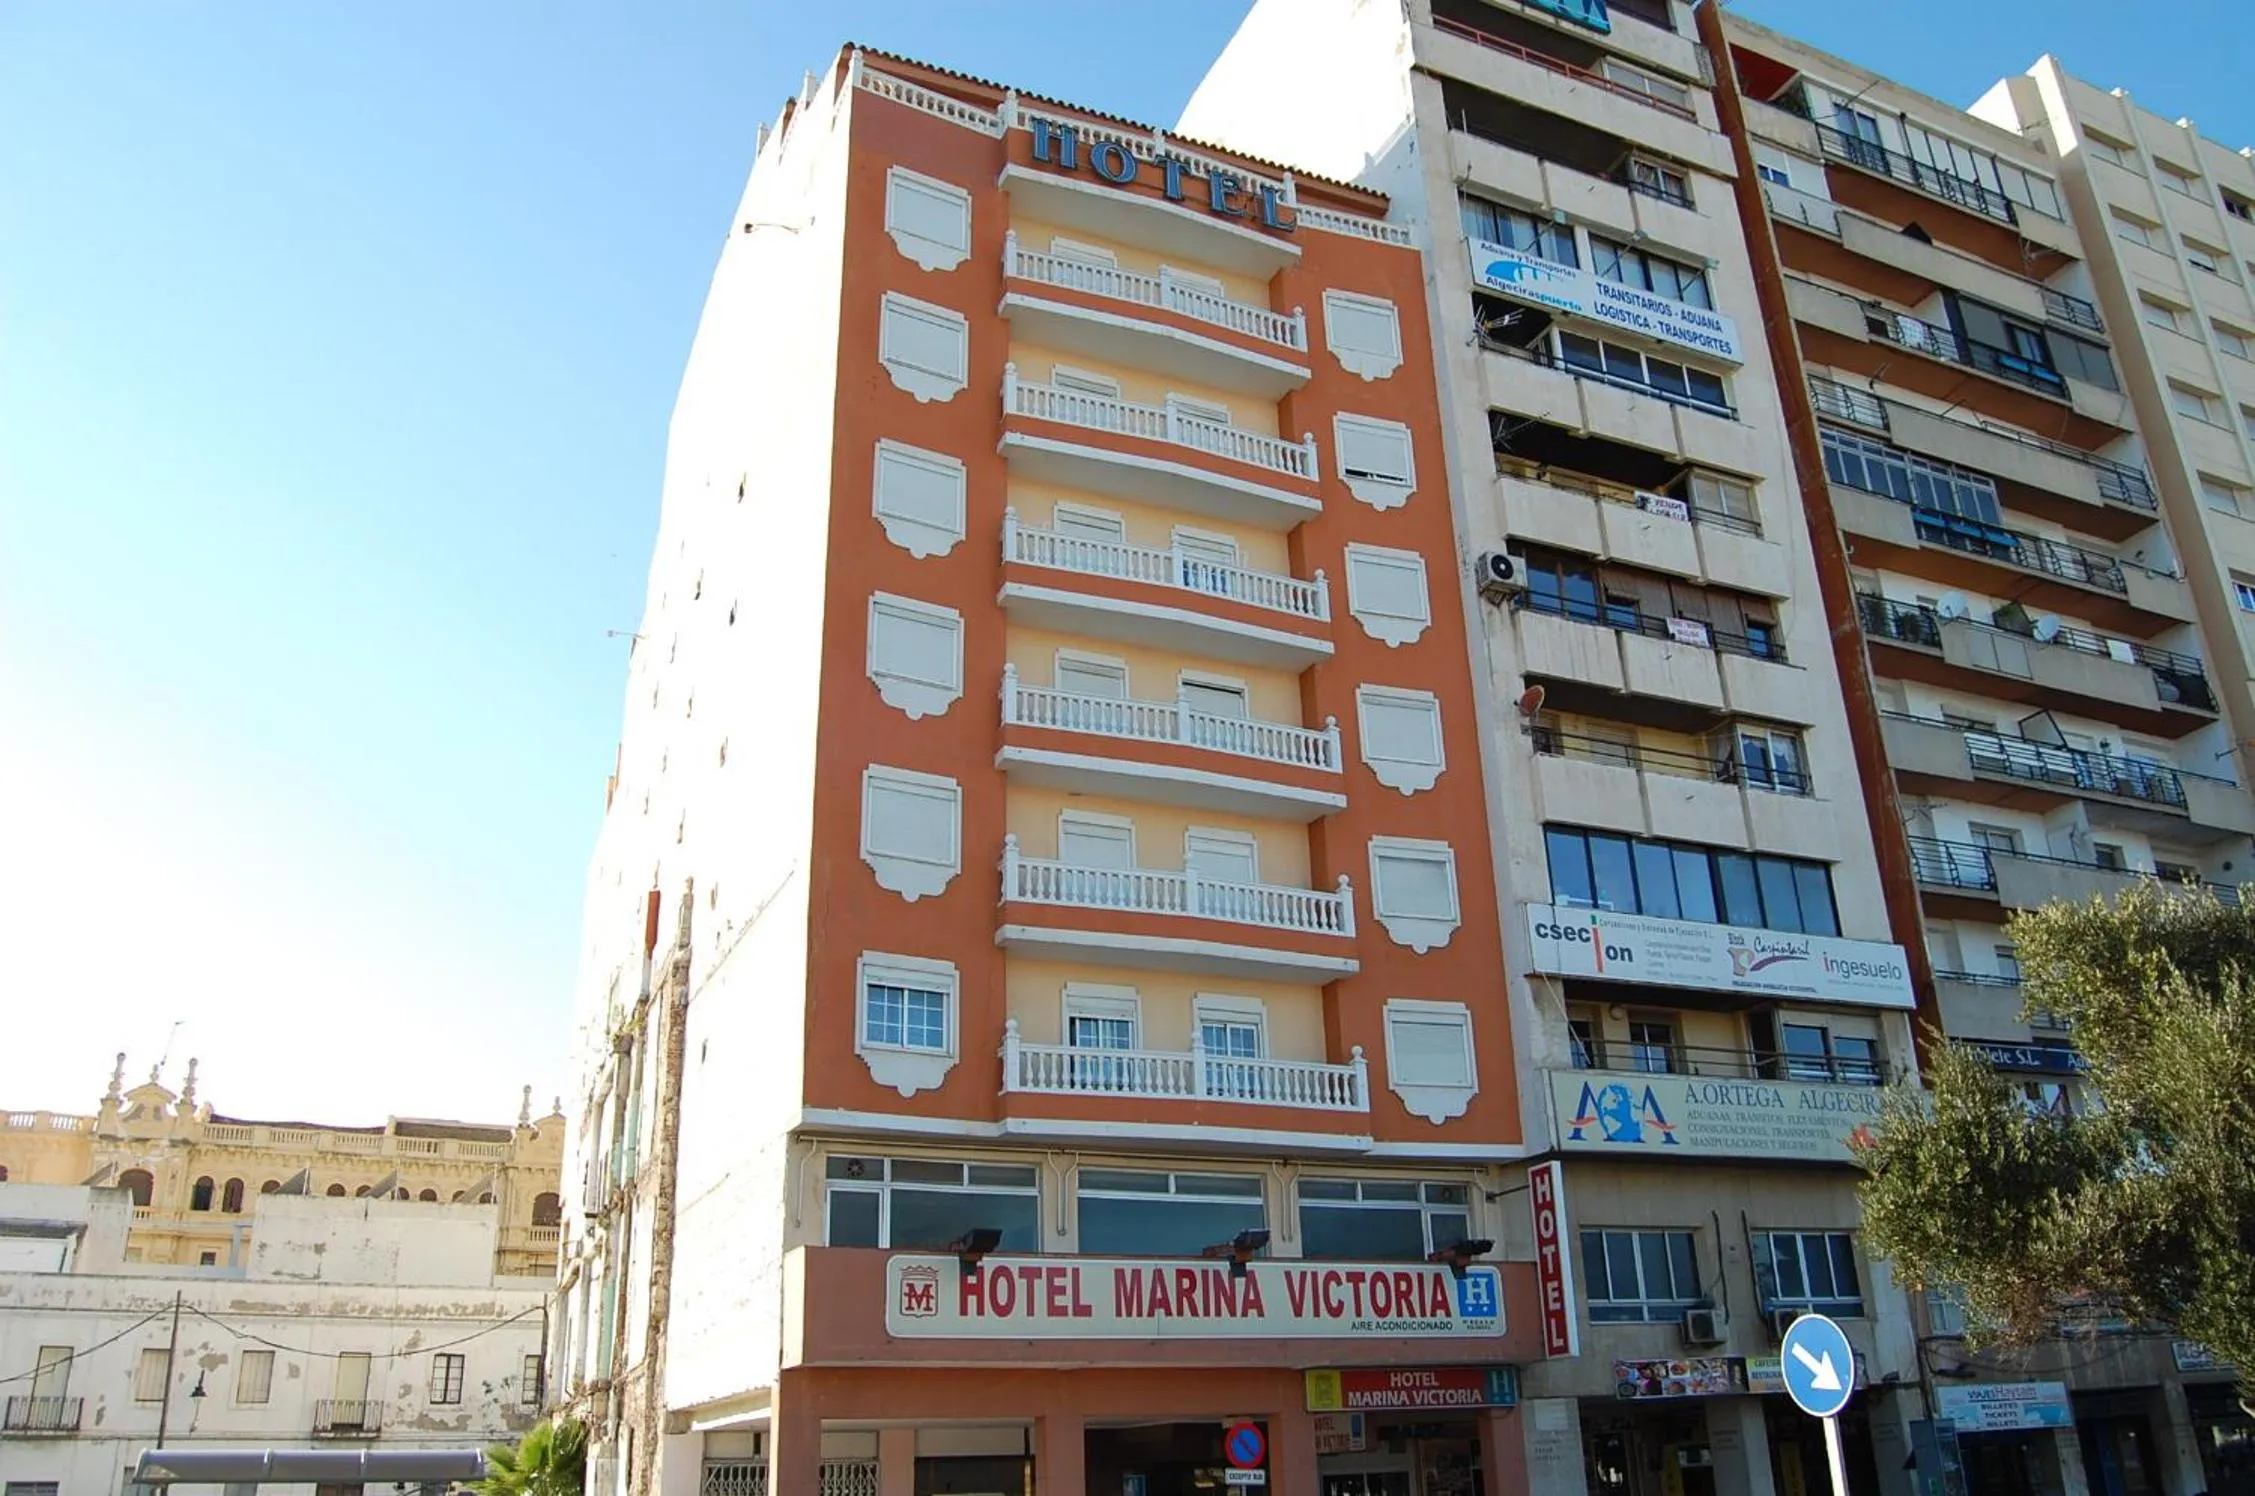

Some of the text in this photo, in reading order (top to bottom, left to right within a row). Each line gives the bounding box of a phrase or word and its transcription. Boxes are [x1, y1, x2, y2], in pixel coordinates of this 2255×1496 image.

[1030, 114, 1298, 233] HOTEL
[1480, 241, 1515, 259] Aduana
[1524, 256, 1577, 278] Transportes
[1596, 282, 1673, 318] TRANSITARIOS
[1680, 308, 1723, 333] ADUANA
[1594, 300, 1651, 330] LOGISTICA
[1657, 320, 1733, 355] TRANSPORTES
[1823, 952, 1902, 980] ingesuelo
[1685, 1083, 1784, 1109] A.ORTEGA
[1535, 1174, 1564, 1348] HOTEL
[959, 1265, 1453, 1319] HOTEL MARINA VICTORIA
[1351, 1321, 1373, 1332] AIRE
[1375, 1321, 1453, 1331] ACONDICIONADO
[1348, 1389, 1483, 1406] MARINA VICTORIA
[1390, 1371, 1440, 1387] HOTEL
